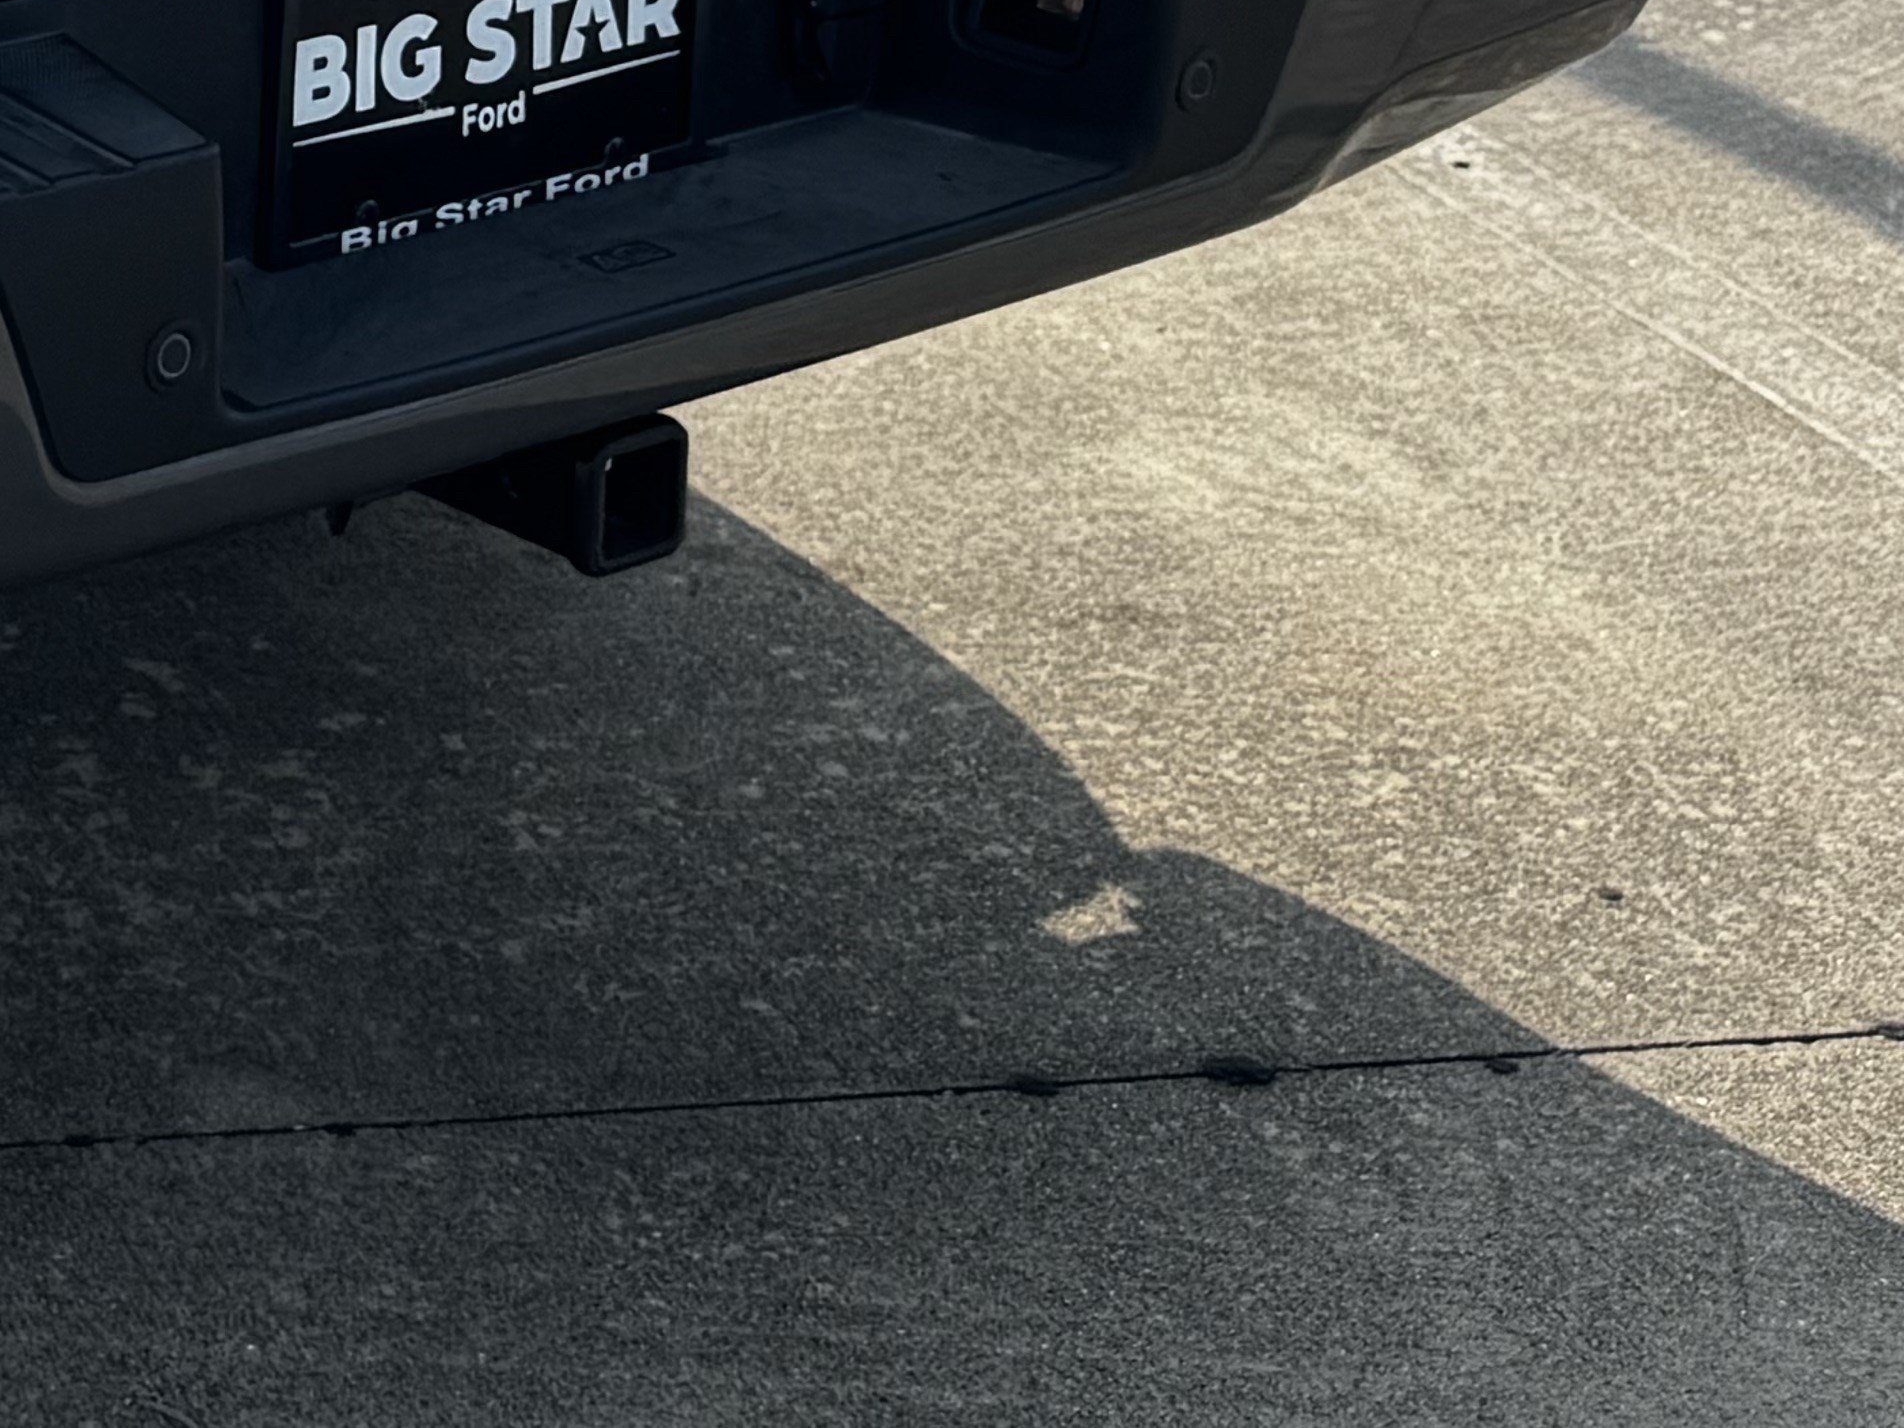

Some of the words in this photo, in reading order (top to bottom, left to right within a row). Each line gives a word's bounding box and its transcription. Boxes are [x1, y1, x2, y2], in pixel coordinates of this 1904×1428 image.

[291, 12, 443, 128] BIG
[460, 88, 527, 138] Ford
[340, 218, 419, 255] Big
[434, 188, 533, 229] Star
[544, 152, 650, 201] Ford
